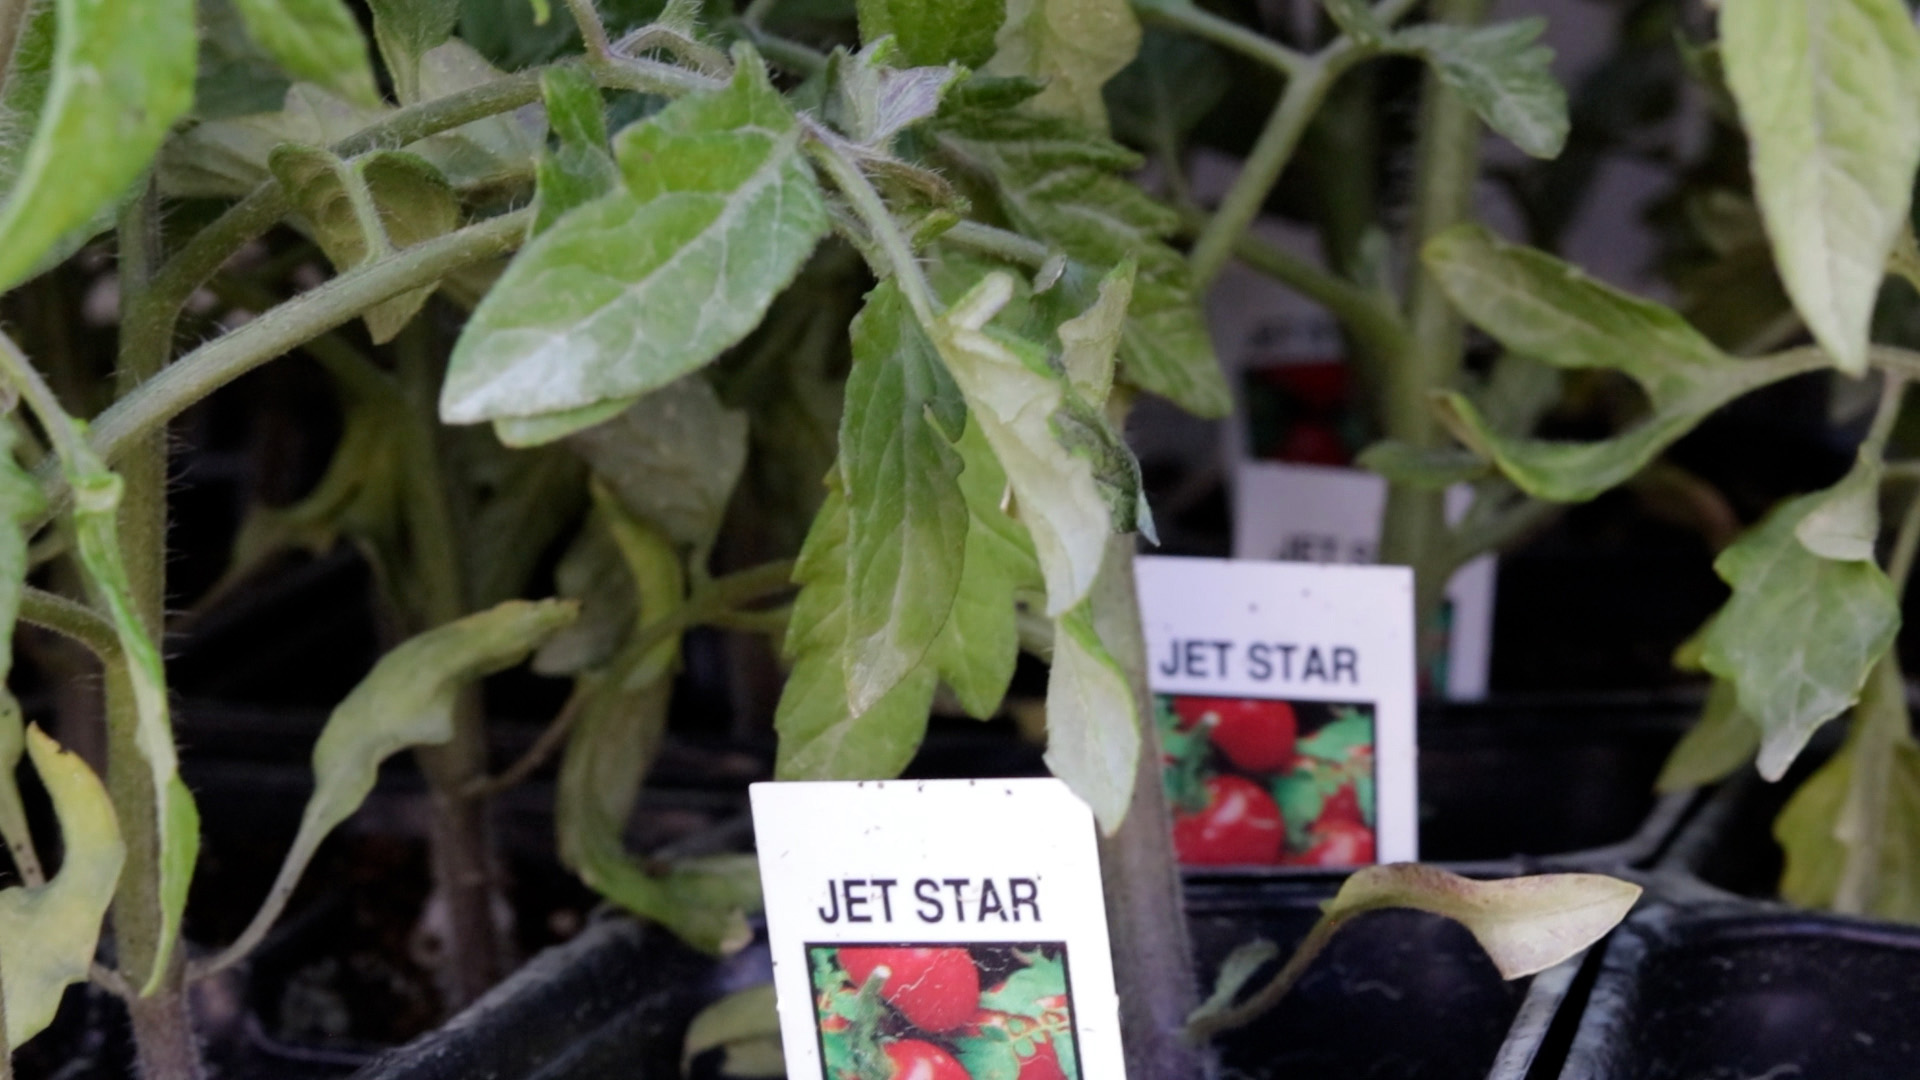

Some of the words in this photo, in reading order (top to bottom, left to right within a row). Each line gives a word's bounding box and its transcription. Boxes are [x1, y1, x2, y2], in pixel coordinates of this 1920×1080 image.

[1160, 640, 1232, 678] JET
[1247, 642, 1359, 684] STAR
[817, 879, 897, 923] JET
[914, 878, 1042, 923] STAR
